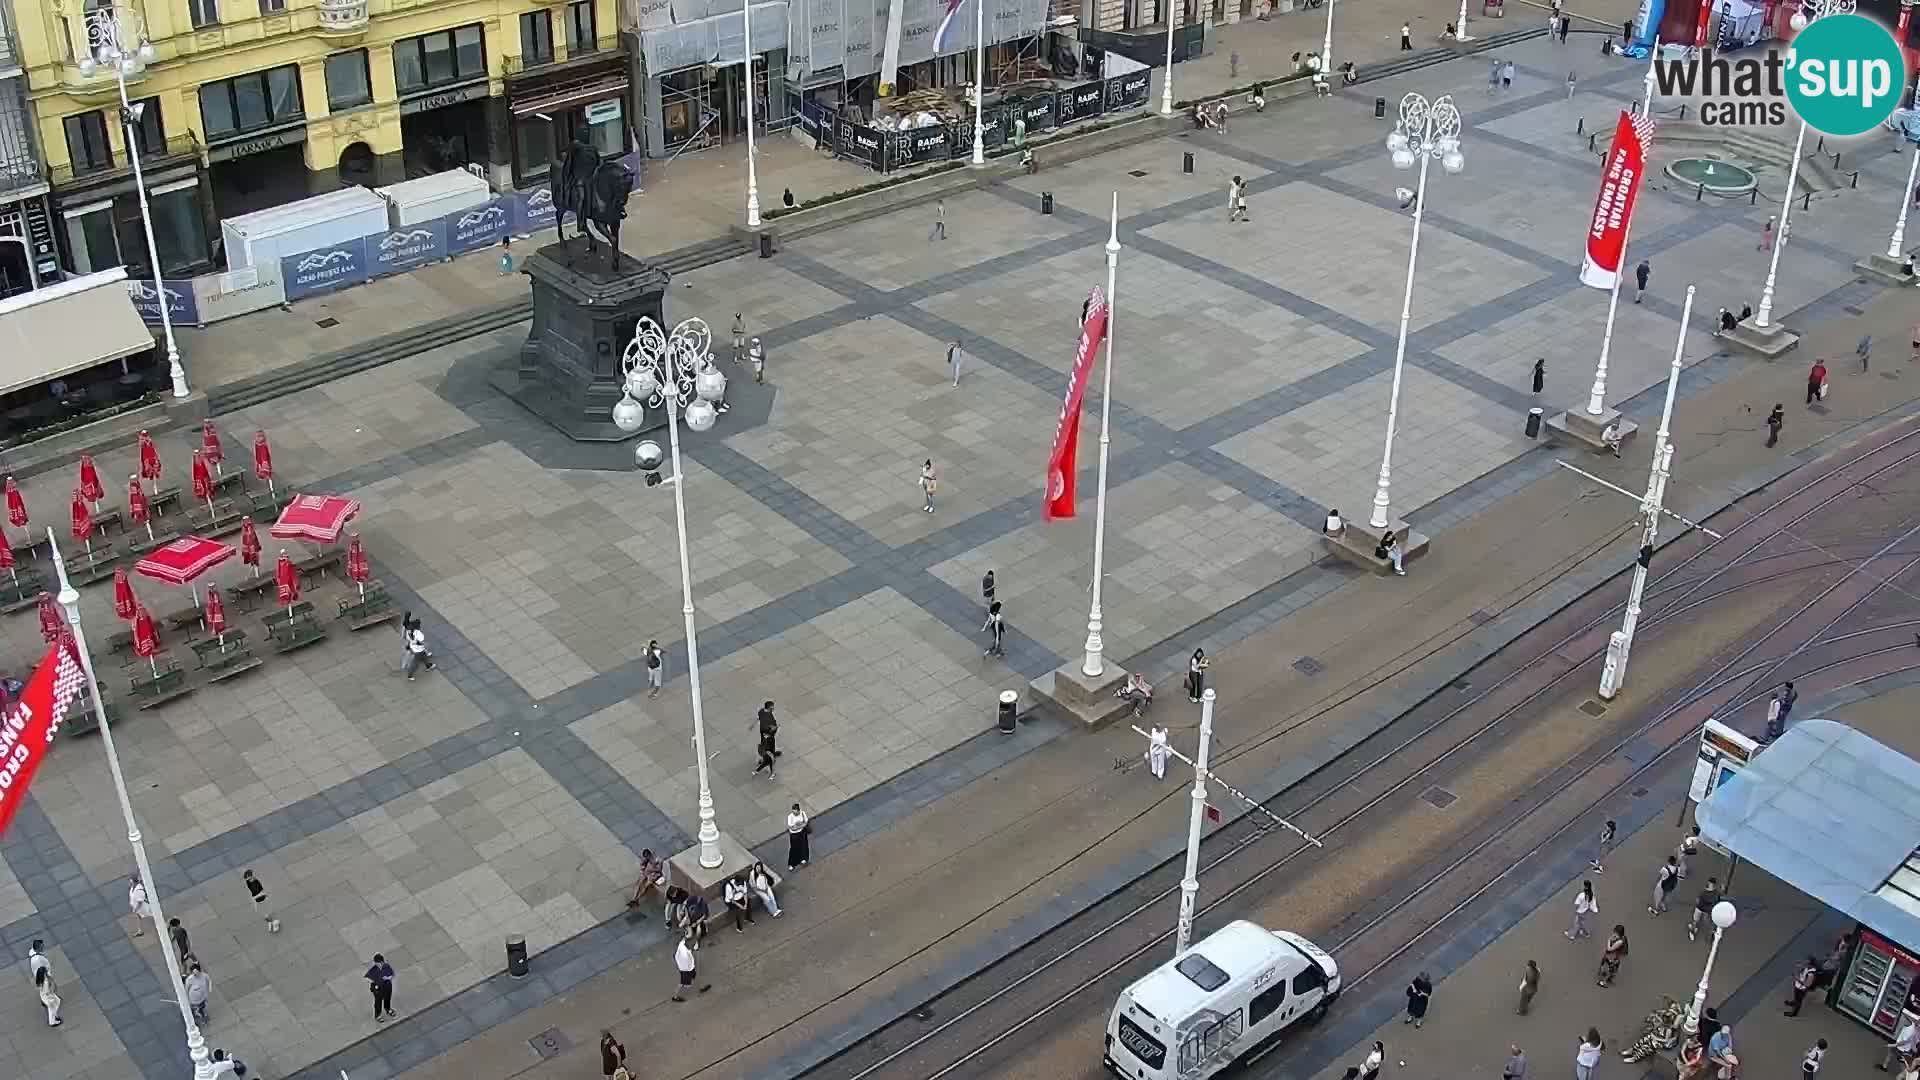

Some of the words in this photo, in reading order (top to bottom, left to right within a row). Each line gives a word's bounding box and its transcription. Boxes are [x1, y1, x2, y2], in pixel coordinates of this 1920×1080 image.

[1609, 148, 1628, 180] FANS
[1591, 181, 1617, 240] EMBASSY
[1608, 168, 1634, 230] CROATIAN
[0, 702, 33, 758] FANS
